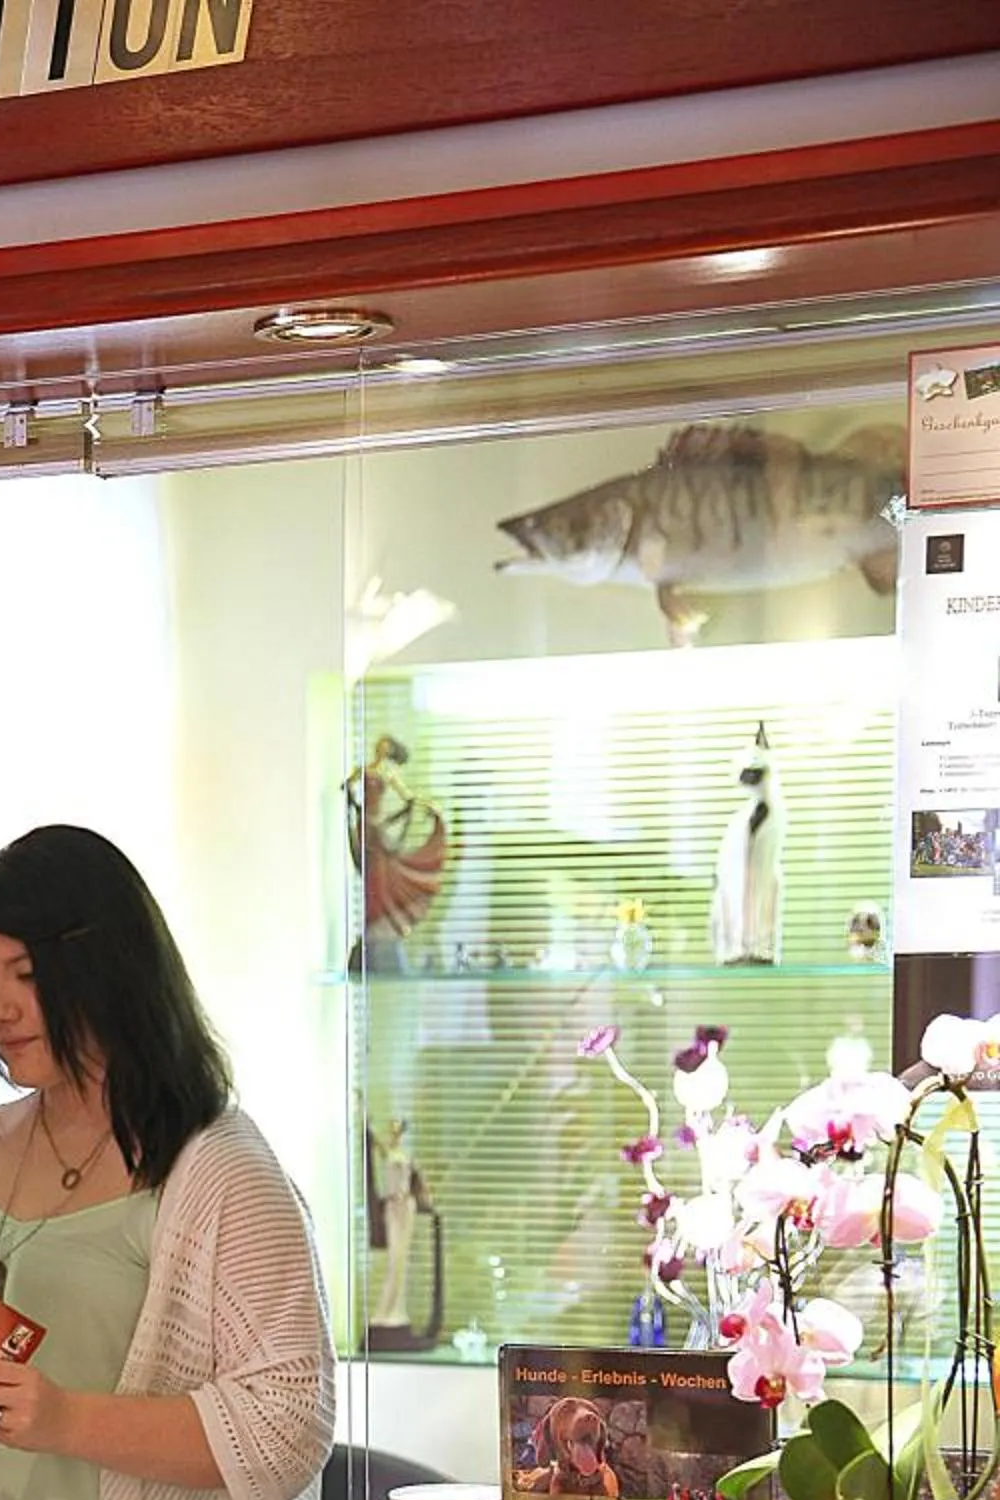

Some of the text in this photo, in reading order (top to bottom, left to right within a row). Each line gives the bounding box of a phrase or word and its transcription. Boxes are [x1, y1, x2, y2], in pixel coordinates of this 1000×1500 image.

[515, 1367, 568, 1383] Hunde
[580, 1369, 647, 1386] Erlebnis
[660, 1371, 728, 1390] Wochen
